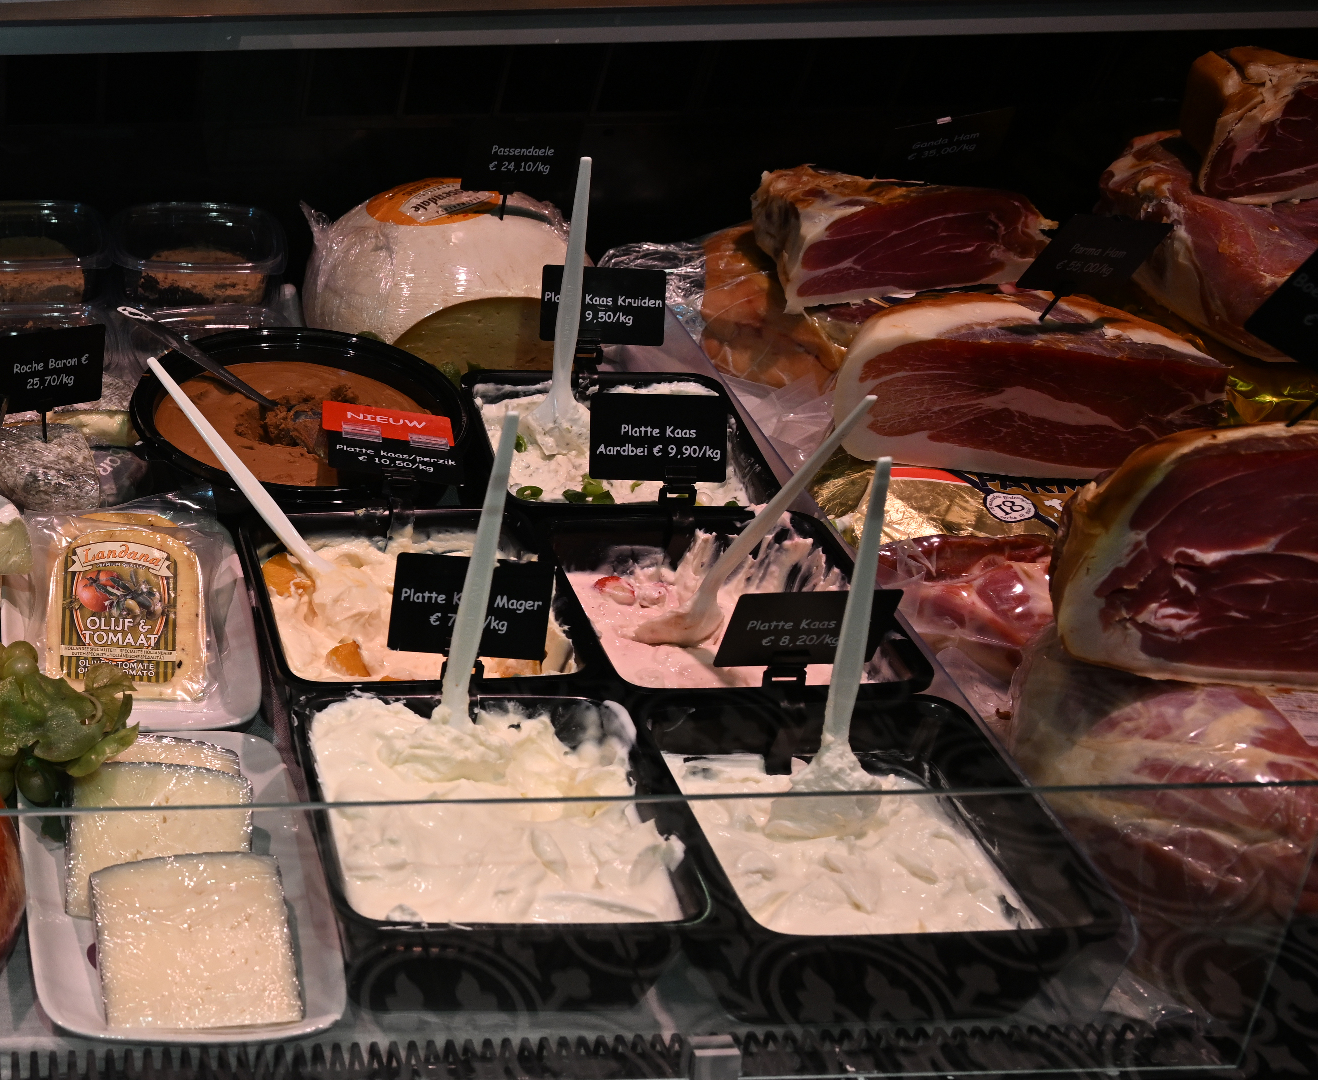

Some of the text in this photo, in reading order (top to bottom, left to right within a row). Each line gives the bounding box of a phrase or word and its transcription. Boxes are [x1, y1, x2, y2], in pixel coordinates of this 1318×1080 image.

[953, 131, 980, 143] Ham
[491, 145, 554, 157] Passendaele
[488, 160, 550, 175] € 24,10/kg
[1069, 243, 1127, 260] Parma Ham
[584, 293, 613, 305] Kaas
[617, 295, 663, 308] Kruiden
[584, 310, 634, 326] 9,50/kg
[13, 353, 90, 375] Roche Baron €
[26, 373, 75, 390] 25,70/kg
[346, 411, 427, 429] NIEUW
[621, 424, 697, 438] Platte Kaas
[336, 444, 457, 467] Platte kaas/perzik
[596, 443, 721, 462] Aardbei € 9,90/kg
[357, 455, 434, 473] € 10,50/kg
[995, 500, 1025, 517] 18
[83, 543, 162, 567] Landana
[401, 587, 447, 605] Platte
[494, 595, 543, 613] Mager
[86, 616, 152, 632] OLIJF &
[429, 613, 441, 627] €
[746, 618, 838, 632] Platte Kaas
[81, 630, 158, 649] TOMAAT
[761, 633, 840, 648] € 8,20/kg
[116, 661, 155, 670] TOMATE
